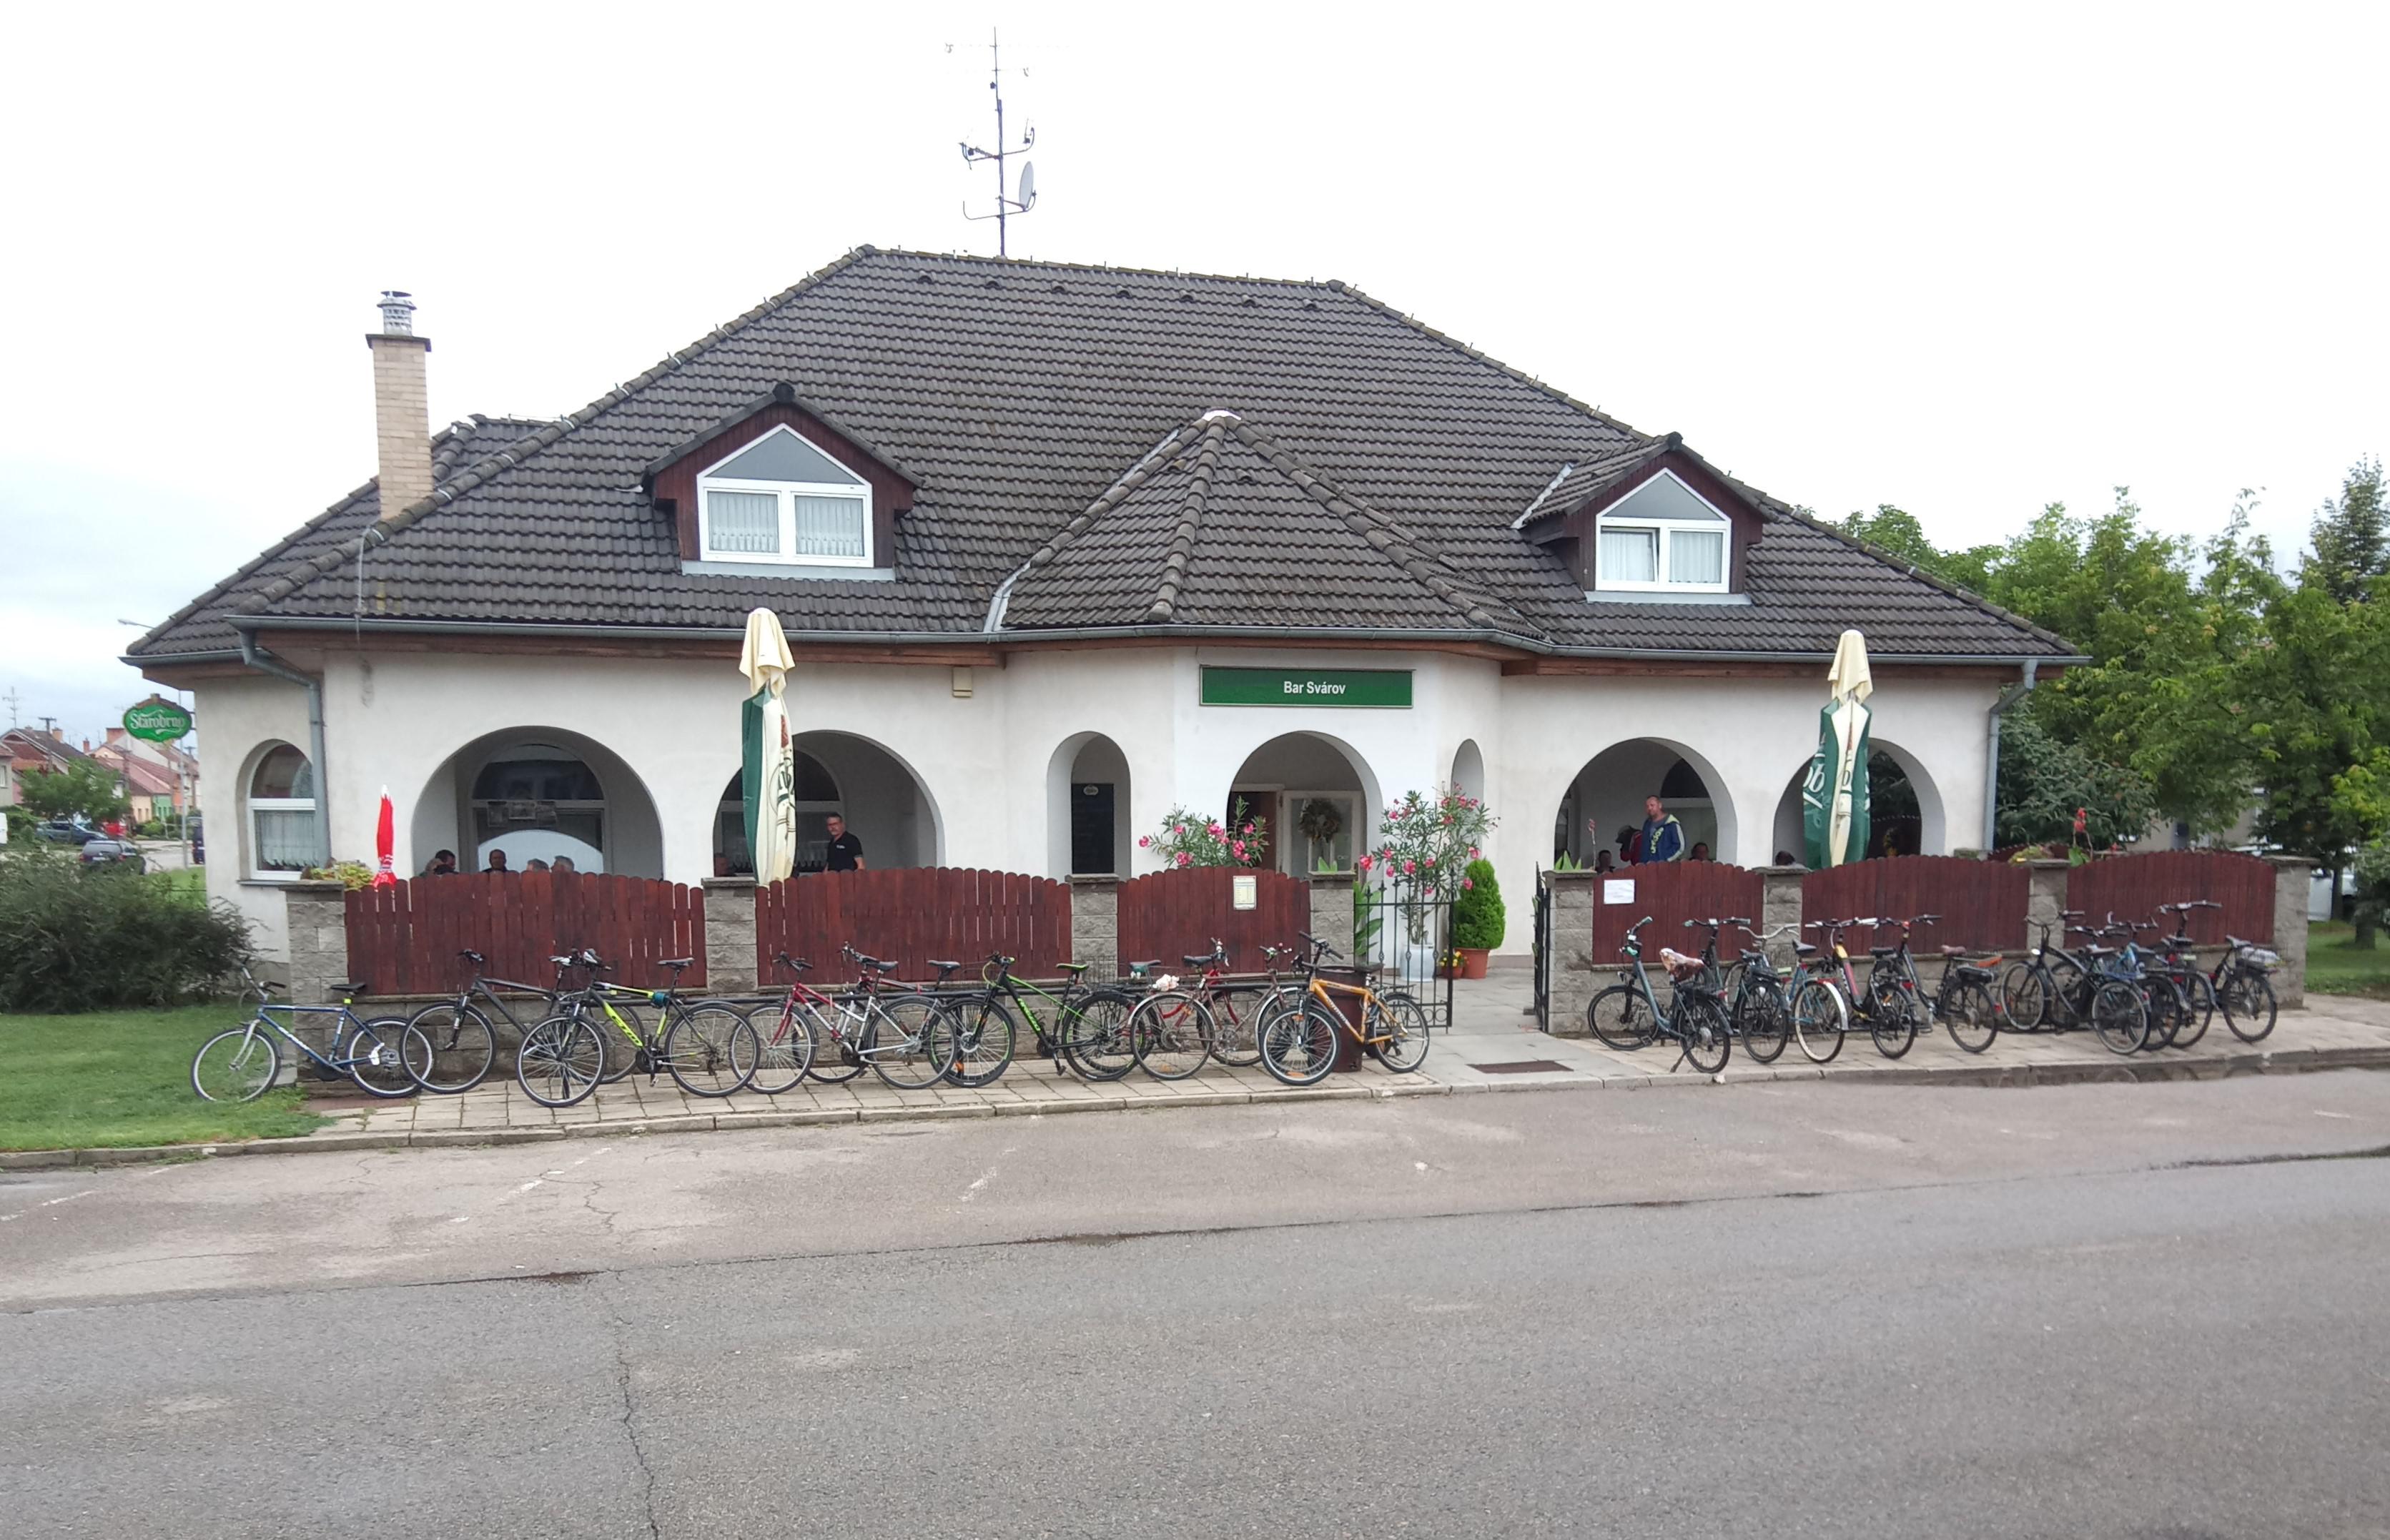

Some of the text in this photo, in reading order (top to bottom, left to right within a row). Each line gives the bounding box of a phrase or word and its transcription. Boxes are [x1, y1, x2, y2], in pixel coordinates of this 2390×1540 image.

[1284, 681, 1345, 694] Bar Svárov
[130, 710, 184, 731] Starobrno
